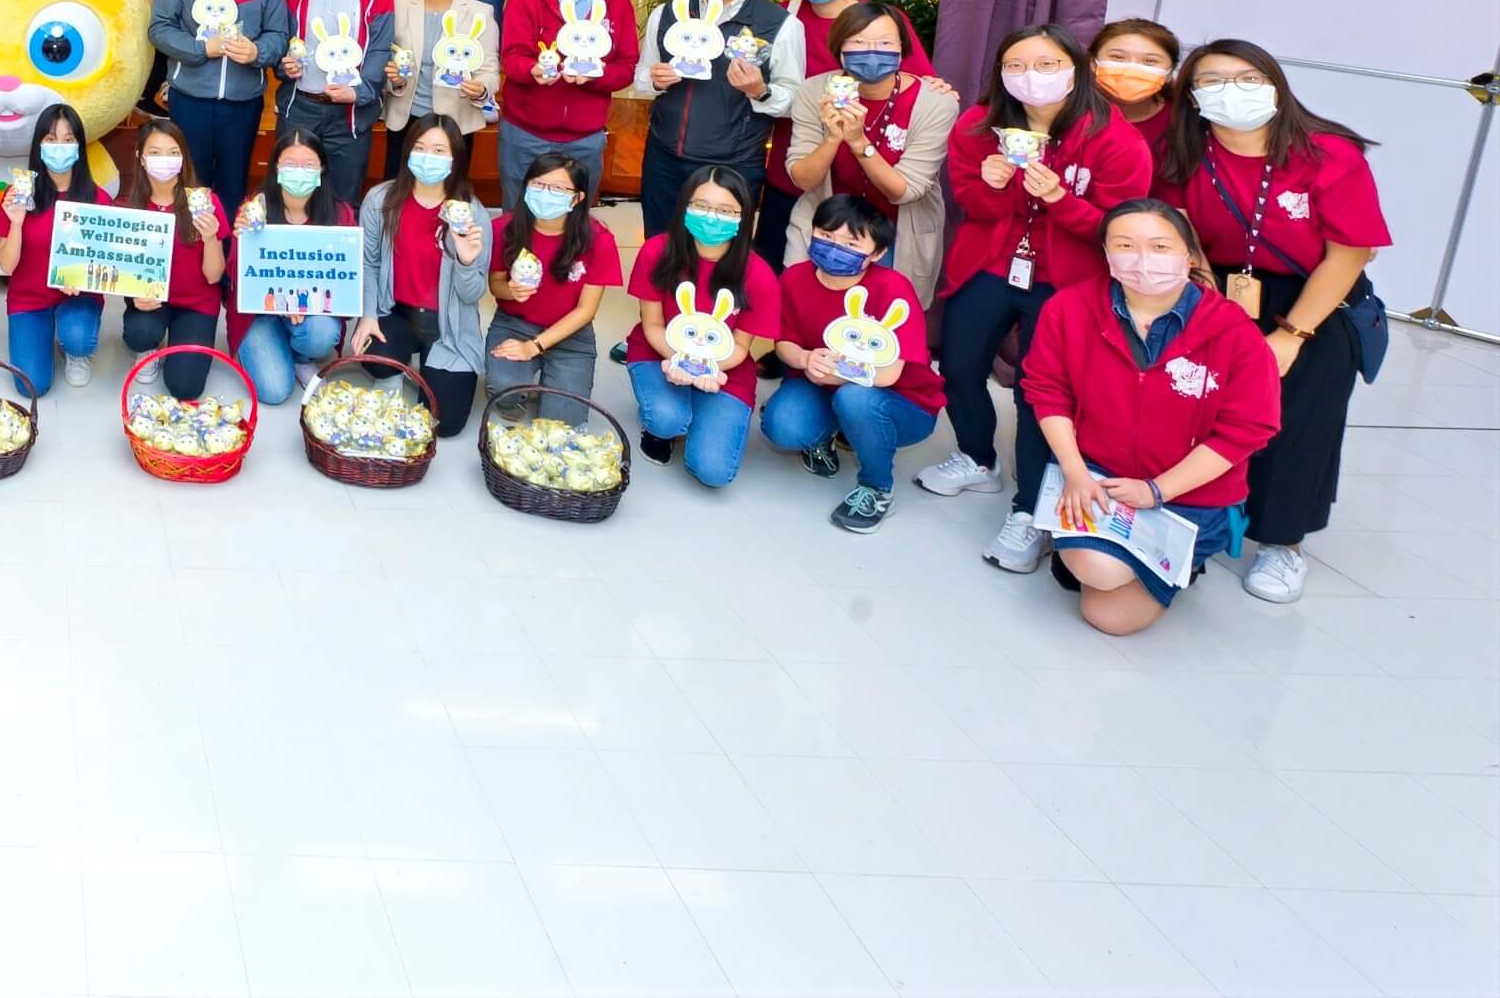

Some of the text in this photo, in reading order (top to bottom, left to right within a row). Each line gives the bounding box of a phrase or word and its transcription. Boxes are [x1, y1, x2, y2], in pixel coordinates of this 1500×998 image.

[62, 211, 169, 234] Psychological
[80, 229, 148, 247] Wellness
[56, 243, 165, 267] Ambassador
[259, 247, 346, 262] Inclusion
[244, 265, 357, 280] Ambassador
